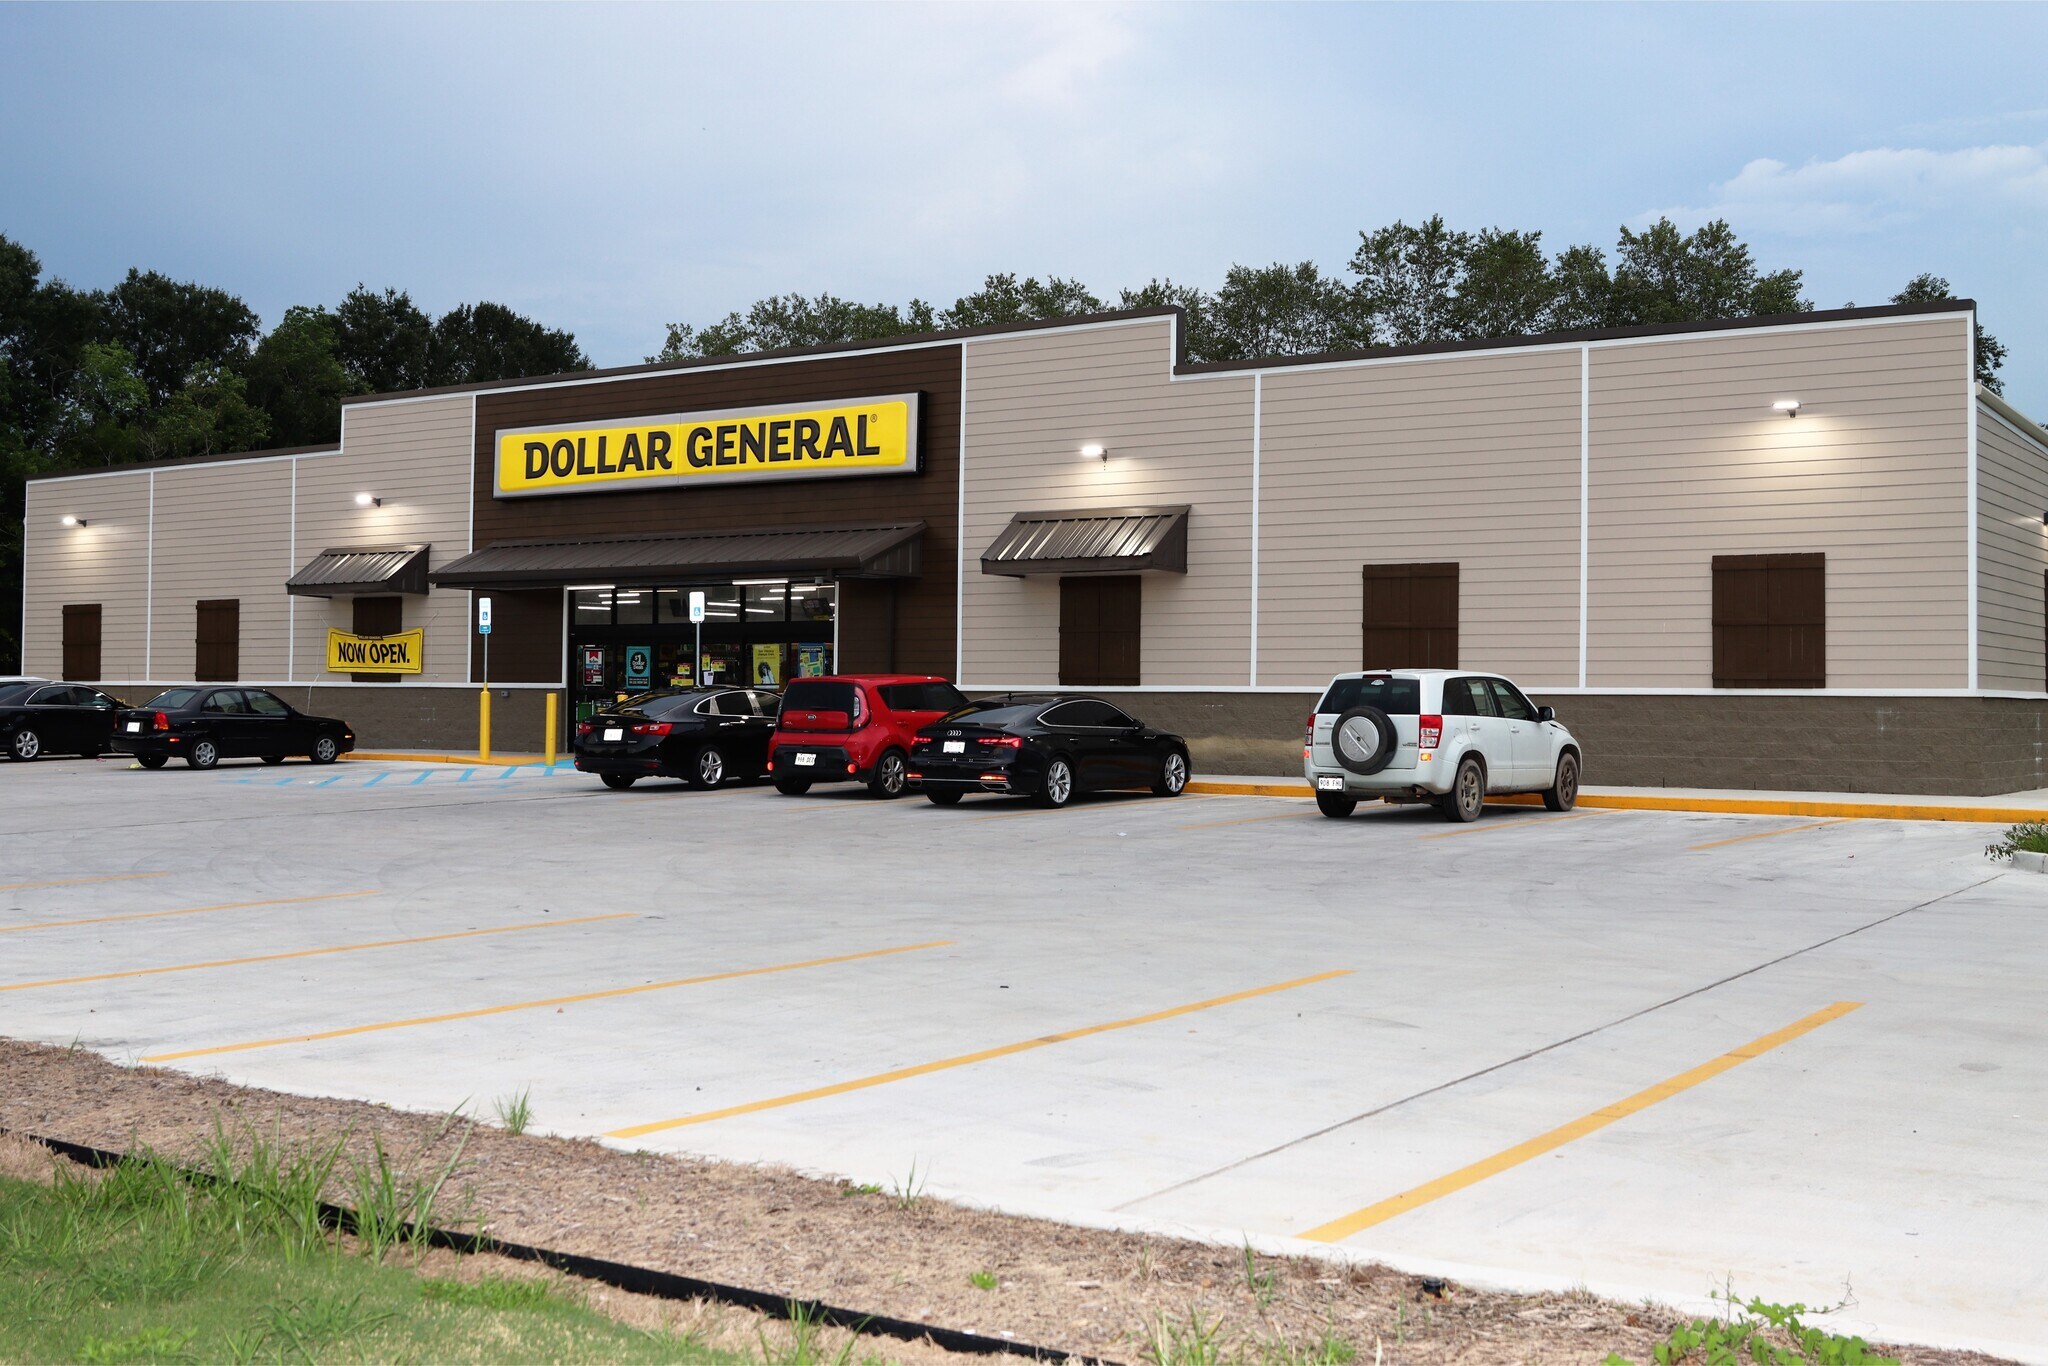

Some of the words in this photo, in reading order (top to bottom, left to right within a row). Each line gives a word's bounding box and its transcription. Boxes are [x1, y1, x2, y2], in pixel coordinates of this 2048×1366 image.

[524, 430, 672, 479] DOLLAR
[686, 414, 880, 468] GENERAL
[338, 642, 367, 663] NOW
[369, 642, 410, 664] OPEN.
